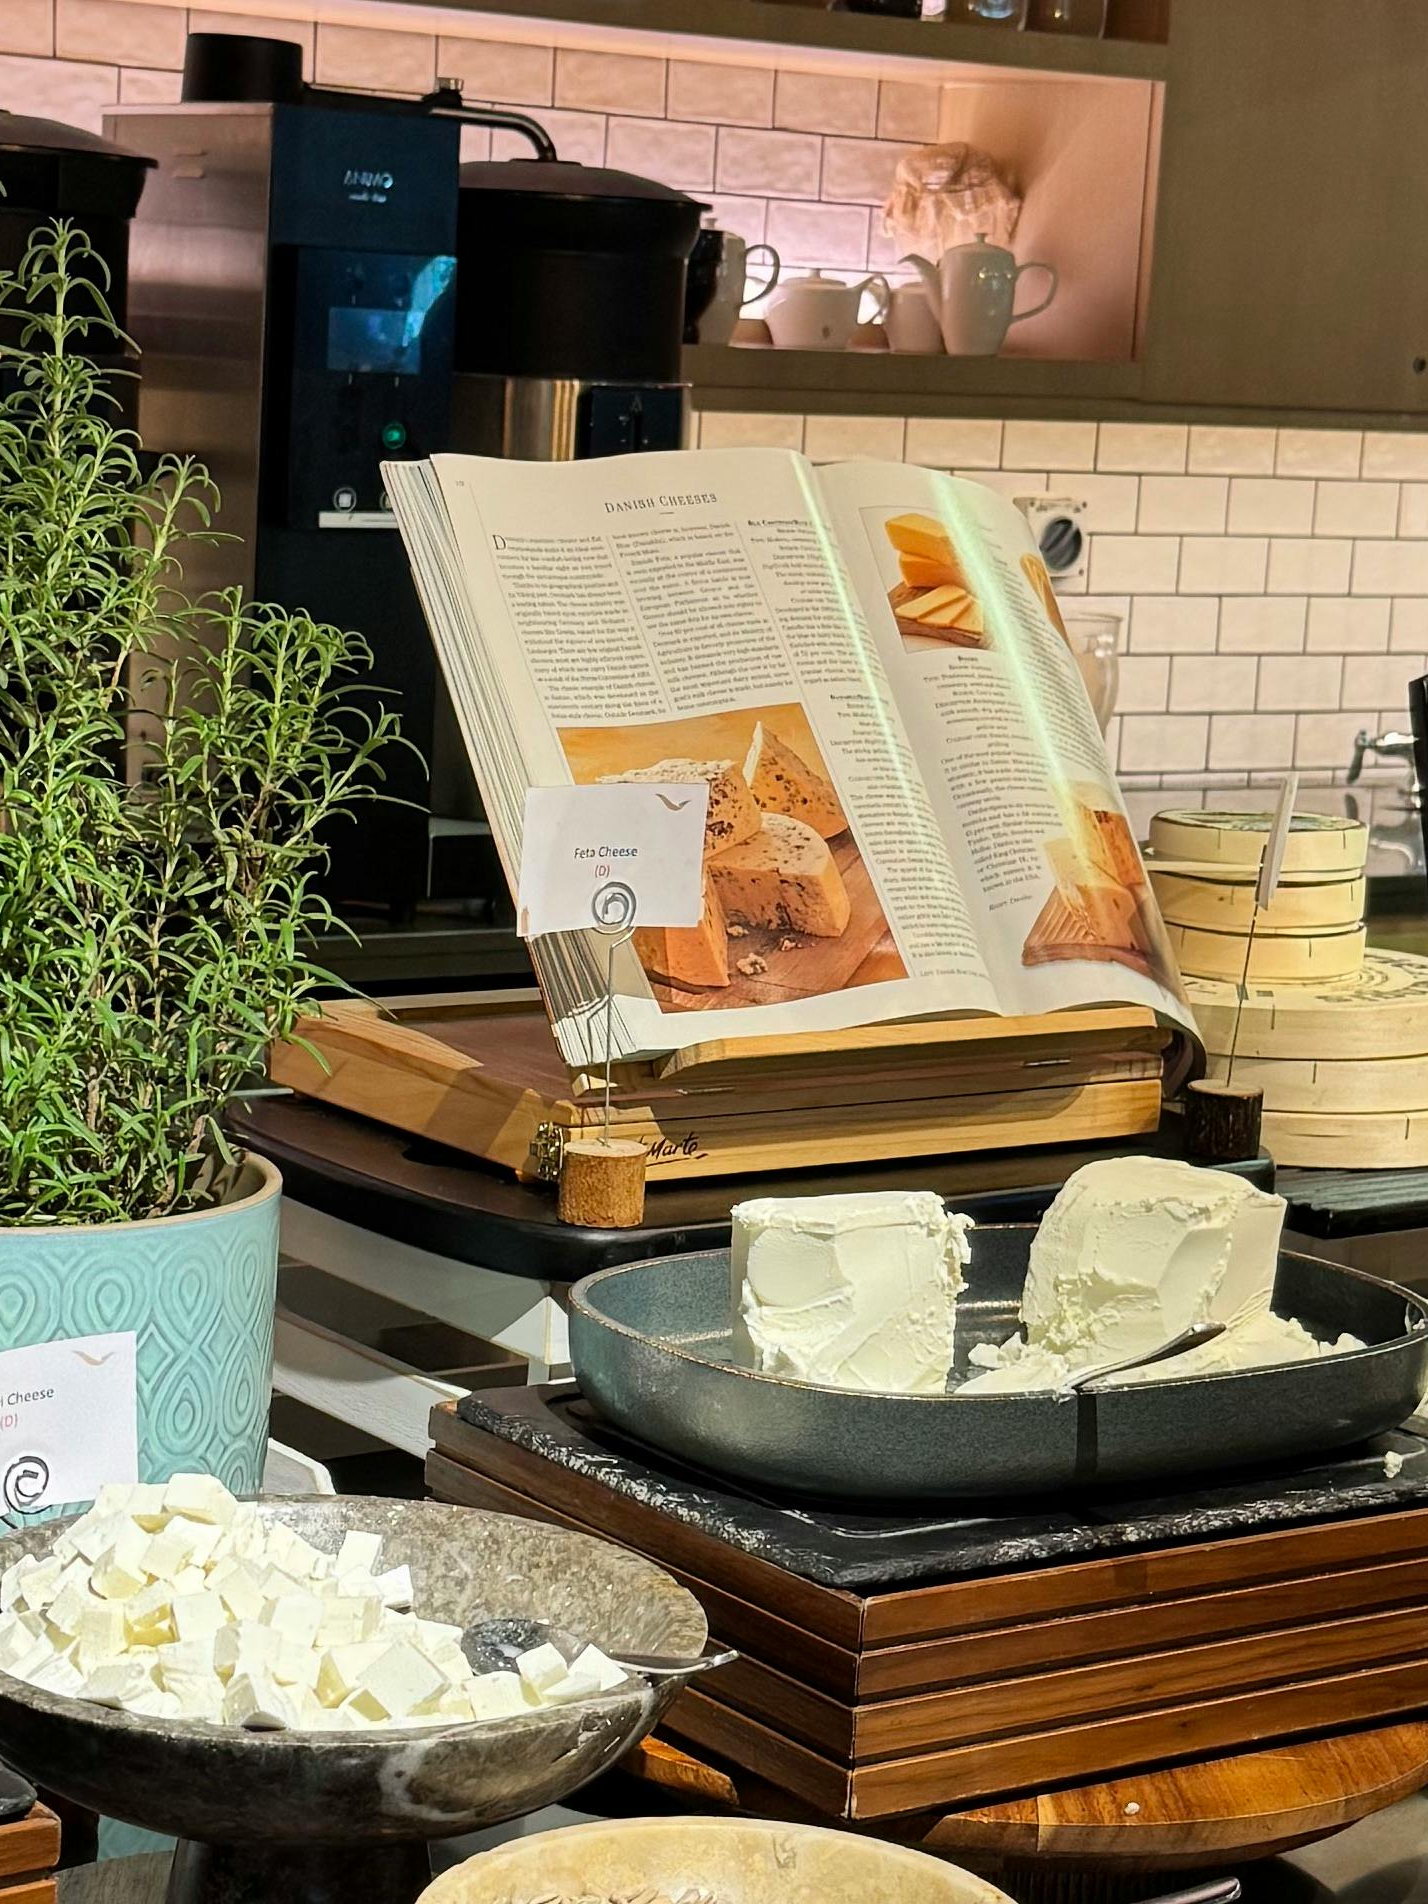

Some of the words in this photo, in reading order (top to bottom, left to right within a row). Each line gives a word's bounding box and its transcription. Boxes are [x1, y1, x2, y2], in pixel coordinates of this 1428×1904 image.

[605, 498, 656, 514] DANISH
[659, 493, 718, 508] CHEESES
[574, 847, 595, 859] Feta
[598, 846, 638, 858] Cheese
[594, 865, 610, 878] (D)
[7, 1387, 55, 1406] Cheese
[0, 1414, 19, 1431] (D)
